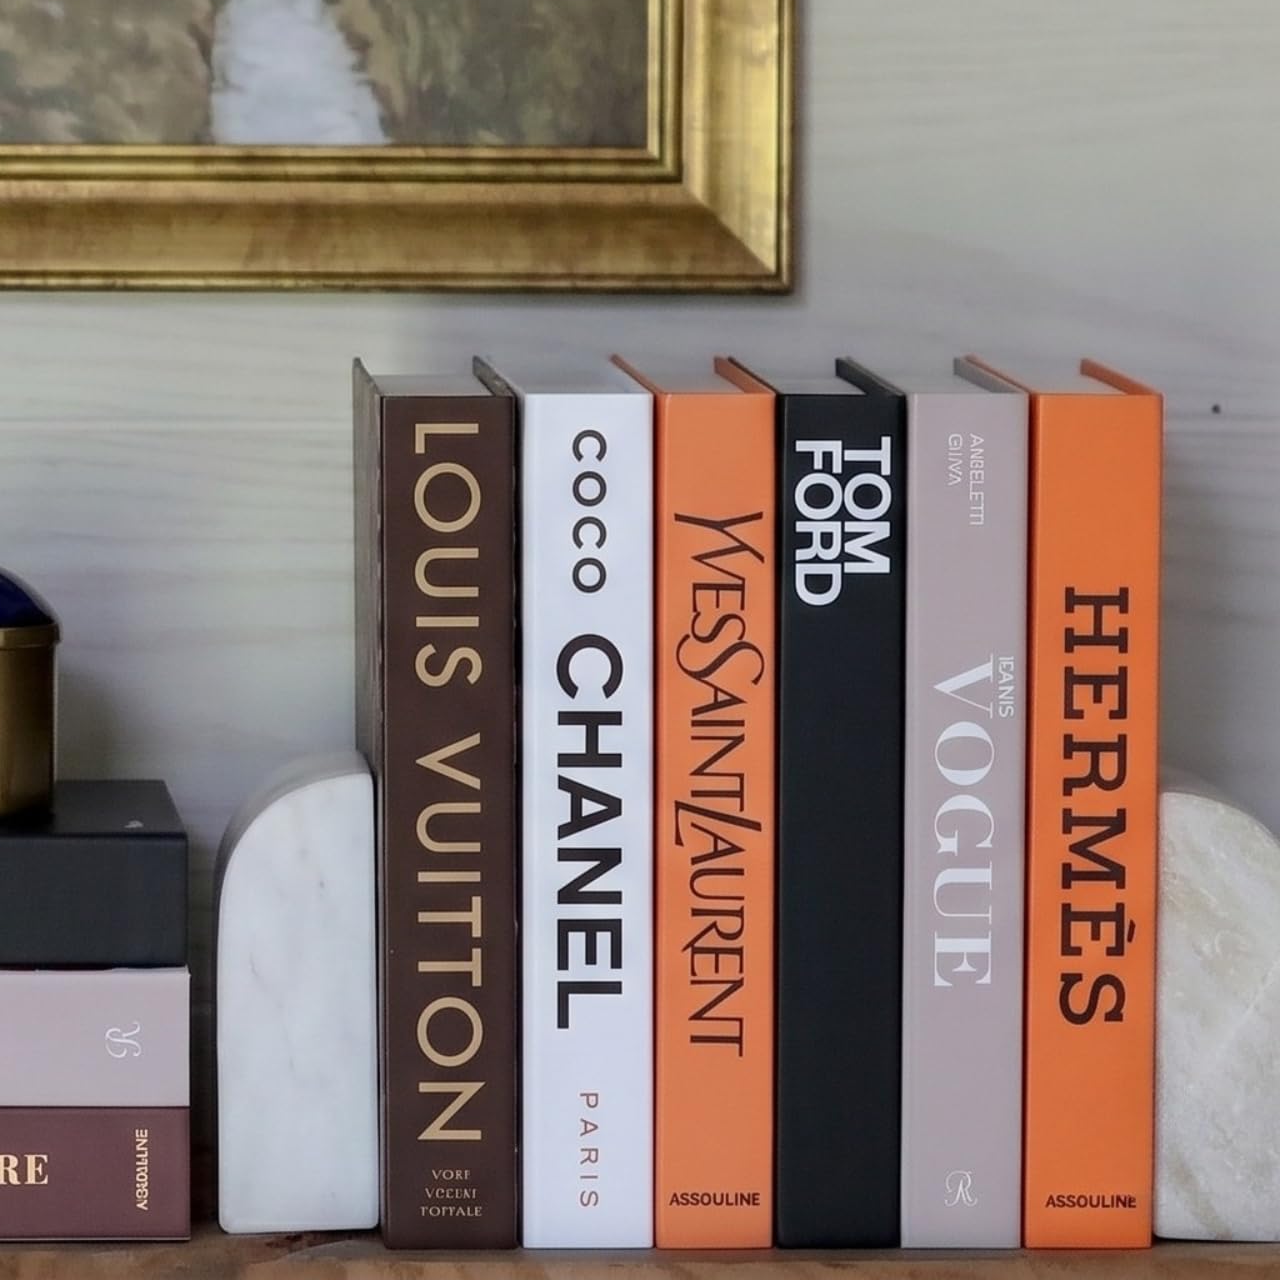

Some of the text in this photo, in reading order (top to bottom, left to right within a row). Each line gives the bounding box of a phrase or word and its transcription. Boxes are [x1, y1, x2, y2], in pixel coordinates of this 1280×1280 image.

[414, 423, 483, 687] LOUIS
[794, 439, 843, 606] FORD
[842, 435, 892, 574] TOM
[556, 429, 624, 1207] COCO CHANEL PARIS
[933, 654, 995, 987] VOGUE
[415, 732, 486, 1141] VUITTON
[668, 1192, 761, 1207] ASSOULINE
[1045, 1194, 1137, 1209] ASSOULINE
